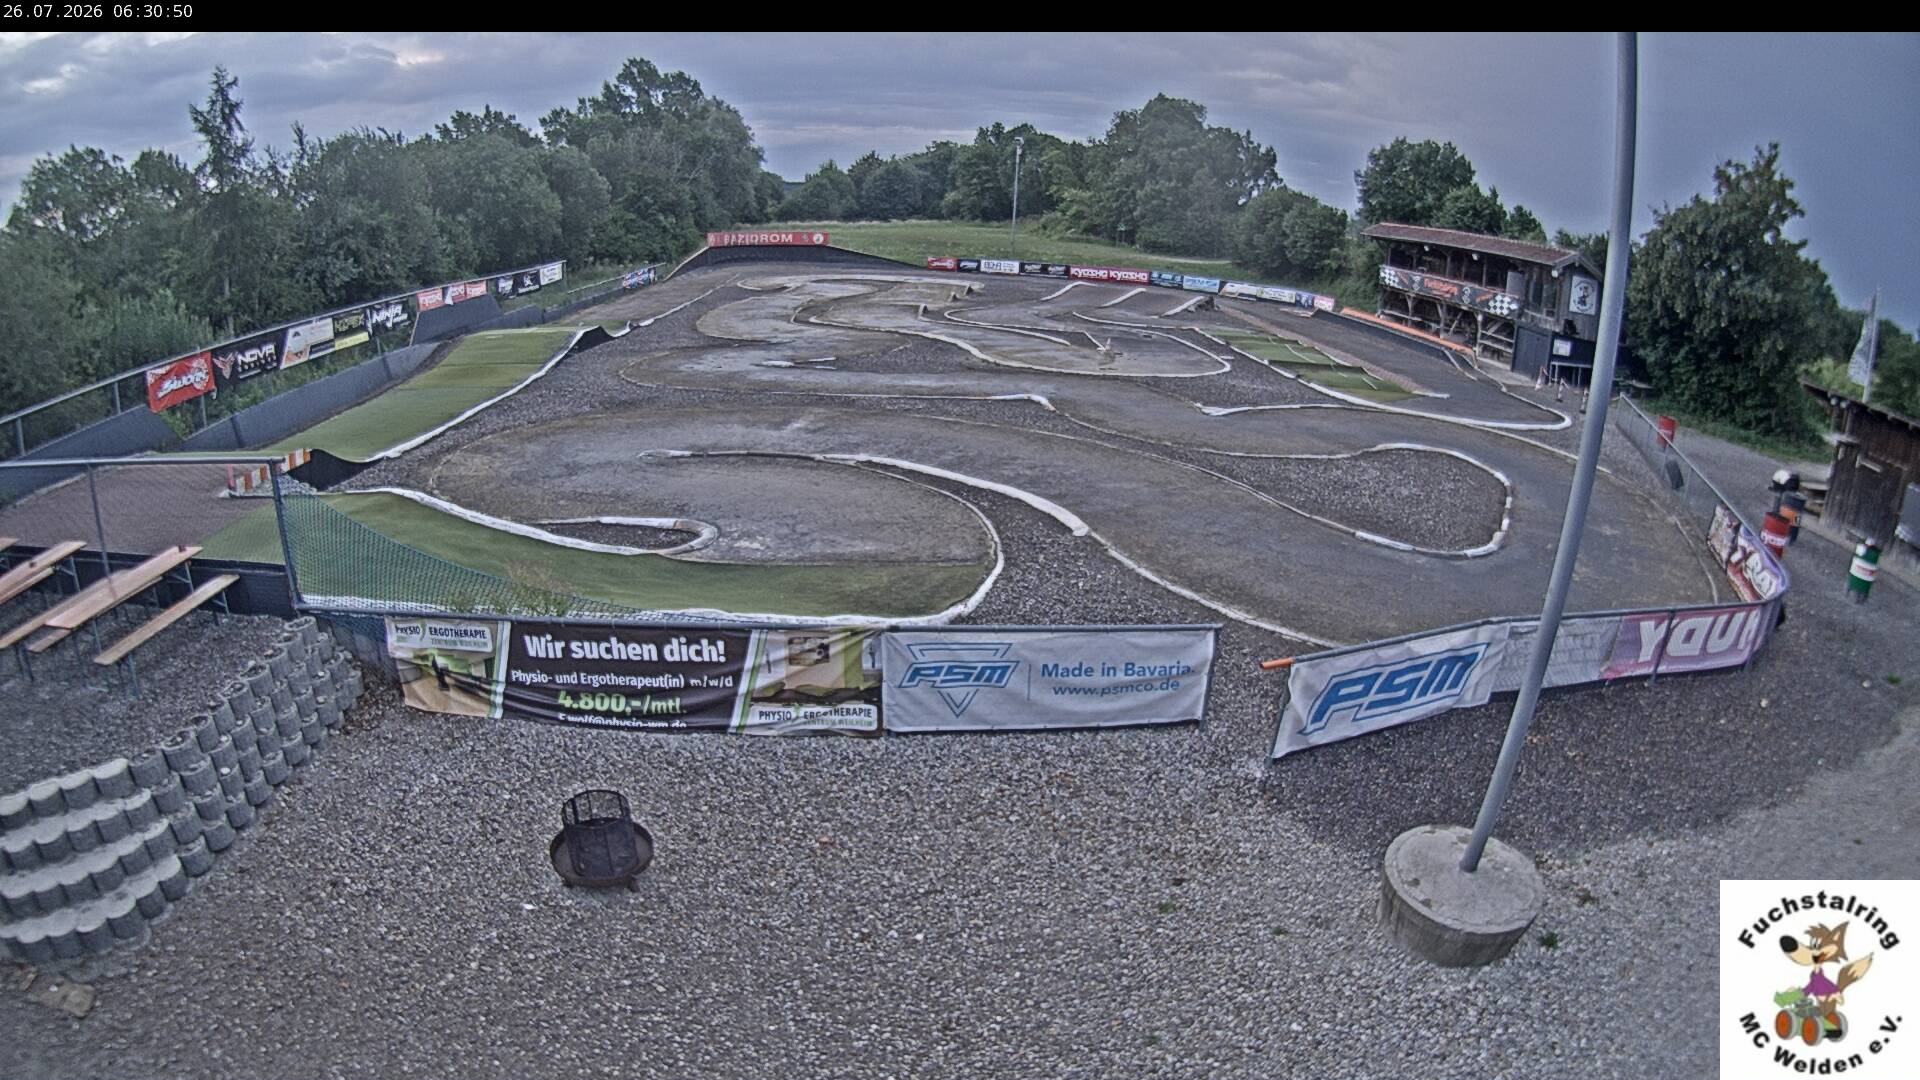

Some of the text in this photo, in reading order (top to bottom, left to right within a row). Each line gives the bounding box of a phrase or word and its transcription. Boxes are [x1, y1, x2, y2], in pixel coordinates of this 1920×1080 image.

[523, 634, 726, 663] Wir suchen dich!
[511, 669, 733, 689] Physio- und Ergotherapeut(in) m/w/d
[903, 663, 1014, 685] PSM
[1041, 662, 1094, 678] Made
[1101, 662, 1116, 678] in
[1052, 679, 1180, 697] www.psmco.de
[1306, 649, 1482, 728] PSM
[758, 710, 792, 721] PHYSIO
